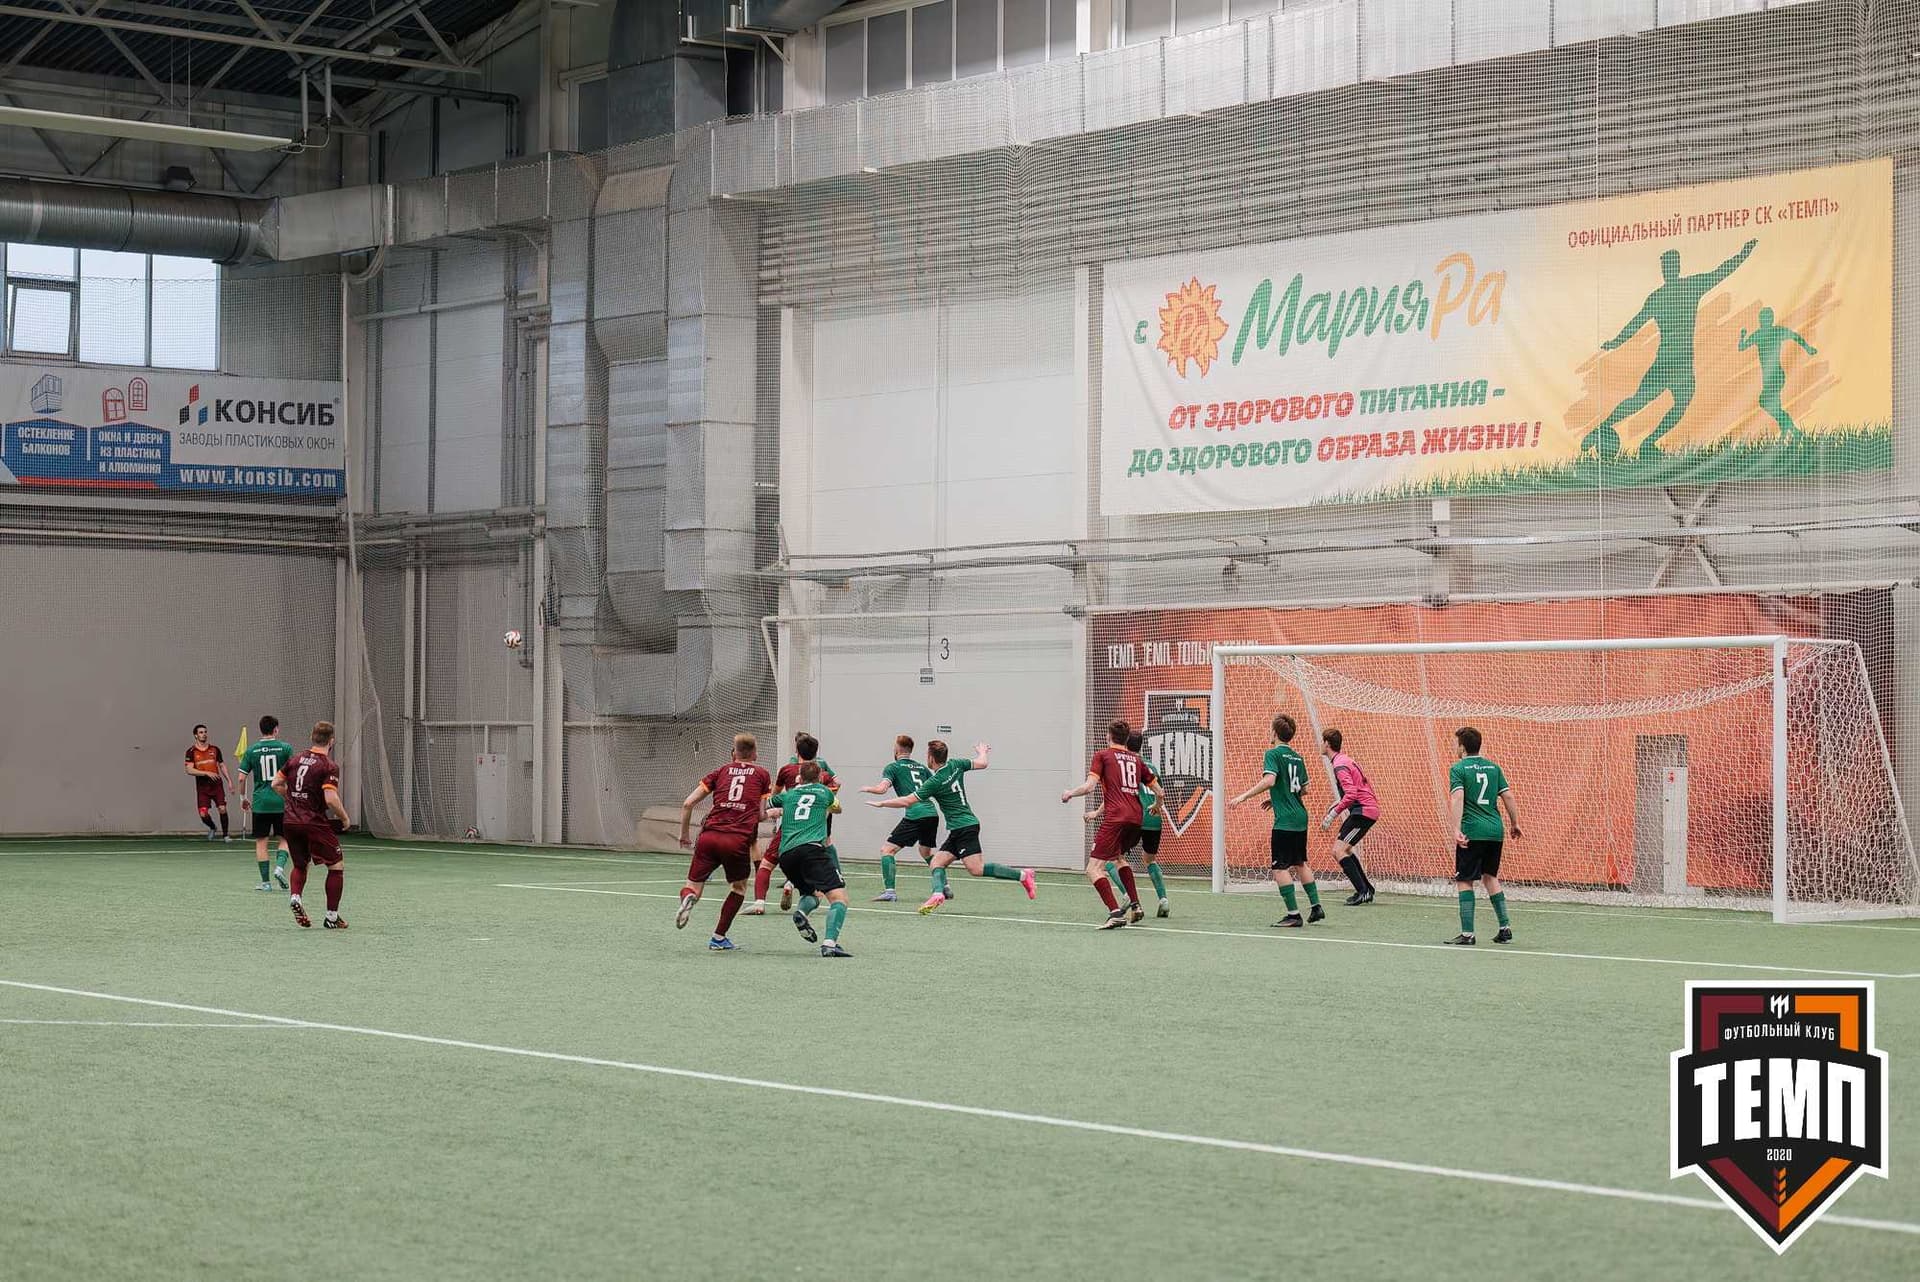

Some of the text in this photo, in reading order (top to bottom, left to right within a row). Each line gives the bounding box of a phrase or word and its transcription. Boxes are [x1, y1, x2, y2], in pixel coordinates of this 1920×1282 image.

[1567, 197, 1840, 248] ОФИЦИАЛЬНЫЙ ПАРТНЕР СК «ТЕМП»
[215, 399, 335, 426] КОНСИБ
[1168, 404, 1201, 430] ОТ
[1204, 391, 1354, 432] ЗДОРОВОГО
[1359, 379, 1489, 415] ПИТАНИЯ
[18, 427, 75, 441] ОСТЕКЛЕНИЕ
[98, 431, 163, 444] ОКНА И ДВЕРИ
[179, 432, 335, 450] ЗАВОДЫ ПЛАСТИКОВЫХ ОКОН
[22, 443, 70, 456] БАЛКОНОВ
[100, 447, 161, 459] ИЗ ПЛАСТИКА
[1127, 448, 1163, 478] ДО
[1167, 438, 1313, 475] ЗДОРОВОГО
[1316, 430, 1417, 463] ОБРАЗА
[99, 462, 161, 474] И АЛЮМИНИЯ
[180, 468, 337, 488] www.konsib.com
[940, 637, 950, 660] 3
[260, 754, 278, 782] 10
[1148, 731, 1210, 782] ТЕМП
[295, 764, 309, 792] 8
[1117, 760, 1138, 788] 18
[728, 775, 746, 802] 6
[1476, 772, 1490, 805] 2
[794, 794, 816, 821] 8
